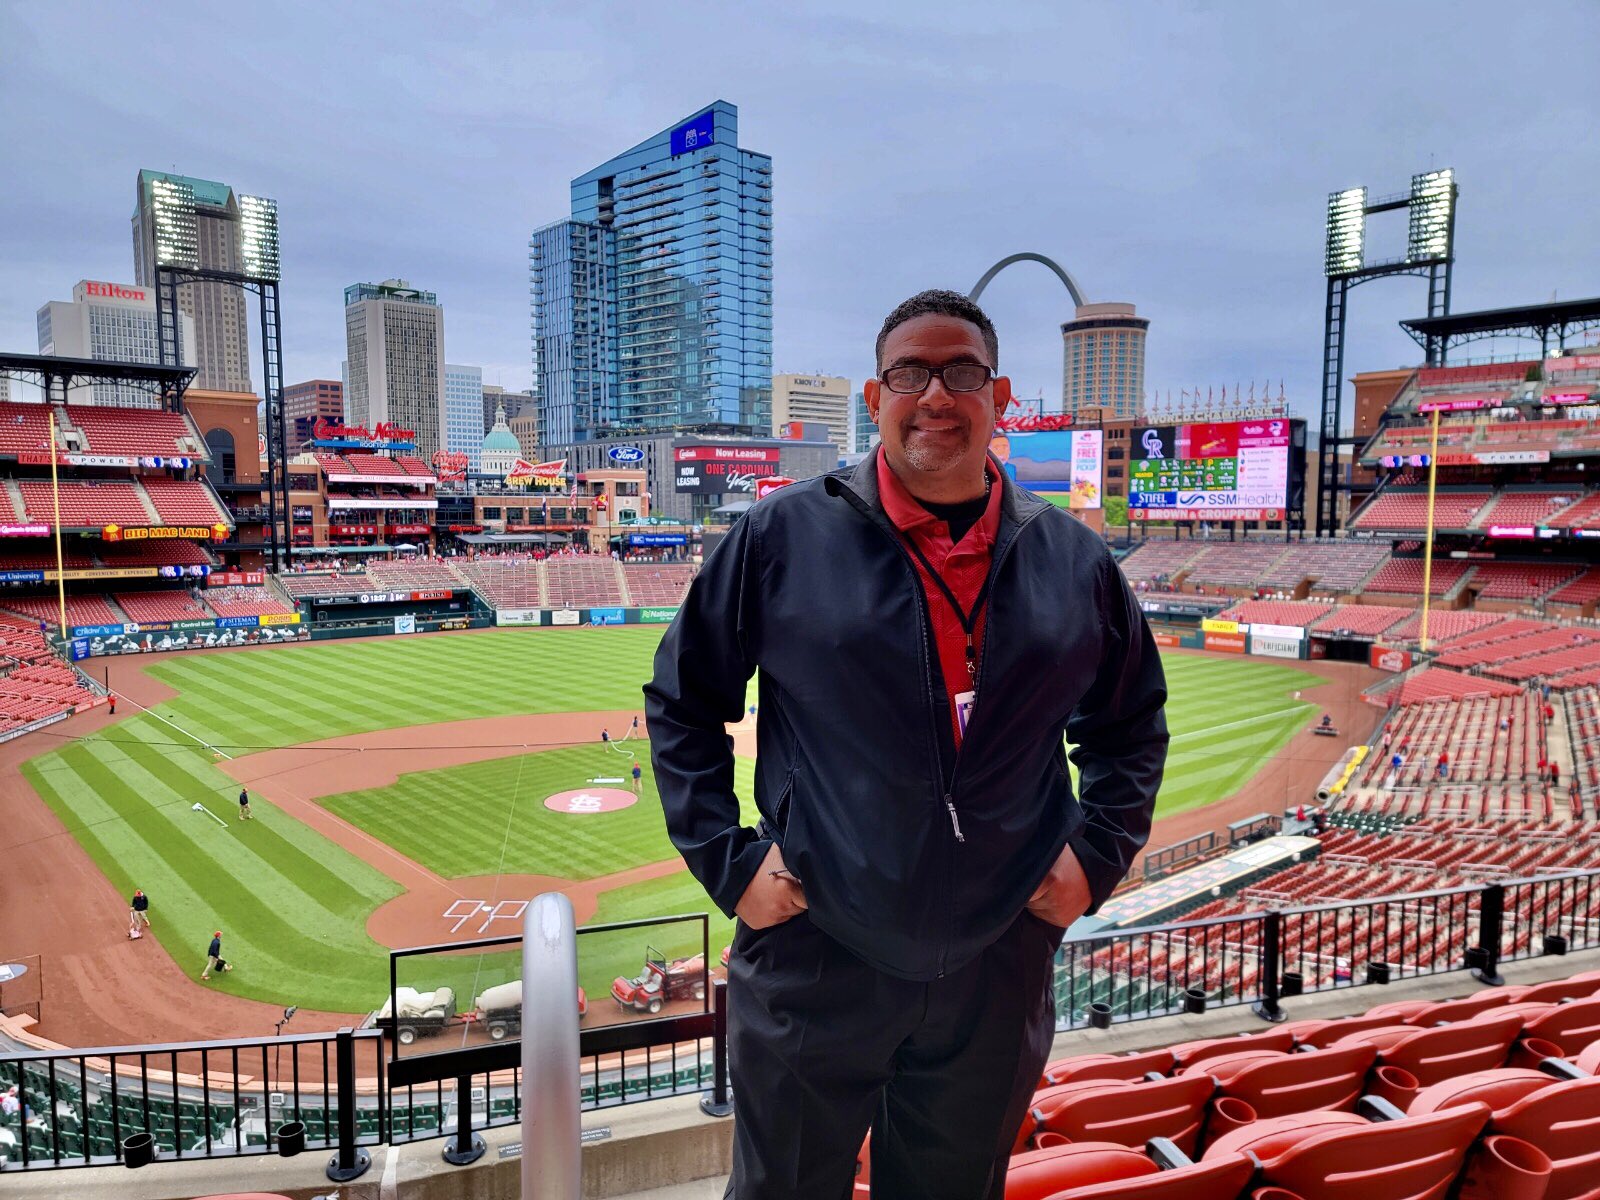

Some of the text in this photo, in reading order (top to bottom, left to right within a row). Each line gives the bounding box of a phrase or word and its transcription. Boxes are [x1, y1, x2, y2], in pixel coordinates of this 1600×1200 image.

[86, 282, 146, 301] Hilton
[794, 378, 813, 387] KMOV
[1148, 406, 1274, 425] WORLD CHAMPIONS
[368, 421, 415, 441] Nation
[360, 440, 388, 449] ROOFTOP
[616, 448, 639, 460] Ford
[679, 448, 697, 460] Cardinals
[716, 448, 767, 460] Now Leasing
[511, 464, 561, 476] Budweiser
[681, 467, 695, 476] NOW
[705, 463, 776, 476] ONE CARDINAL
[506, 476, 567, 487] BREW HOUSE
[676, 476, 700, 487] LEASING
[1138, 491, 1168, 504] STIFEL
[1148, 508, 1262, 520] BROWN & CROUPPEN
[124, 527, 210, 539] BIG MAC LAND
[7, 572, 41, 580] University
[228, 616, 257, 624] SITEMAN
[650, 610, 678, 618] Nationa
[180, 620, 215, 629] Central Bank
